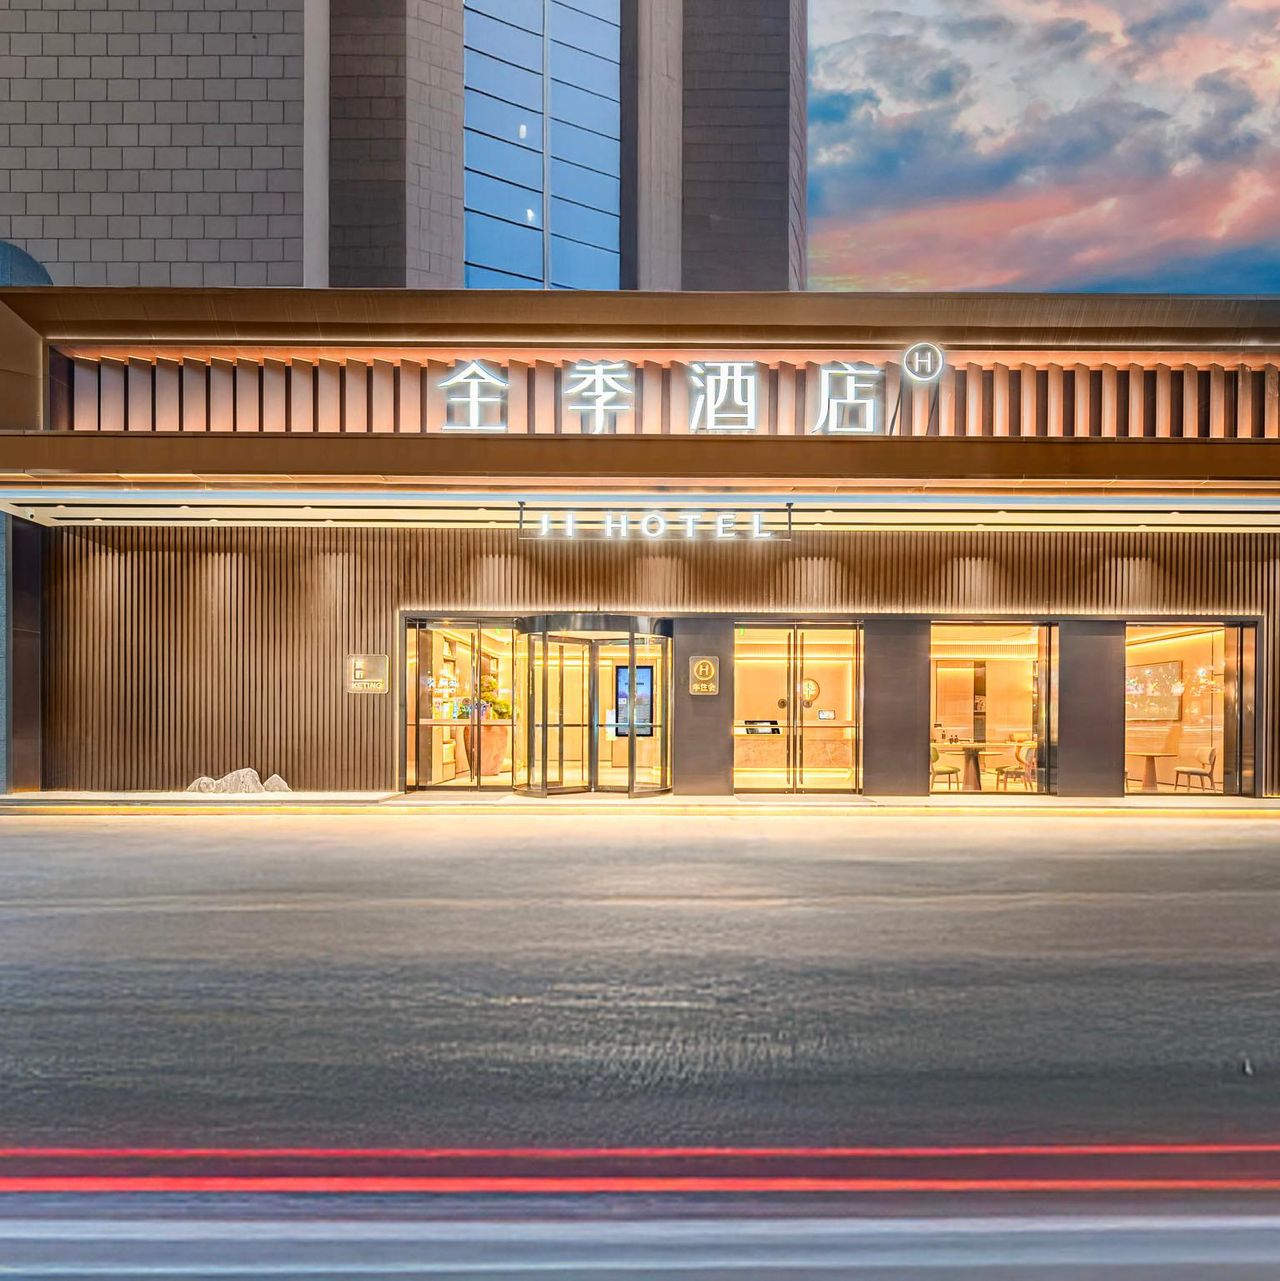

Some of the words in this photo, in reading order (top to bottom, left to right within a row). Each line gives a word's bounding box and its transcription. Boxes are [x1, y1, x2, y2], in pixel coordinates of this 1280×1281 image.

[437, 360, 881, 435] 全季酒店
[606, 512, 771, 538] HOTEL
